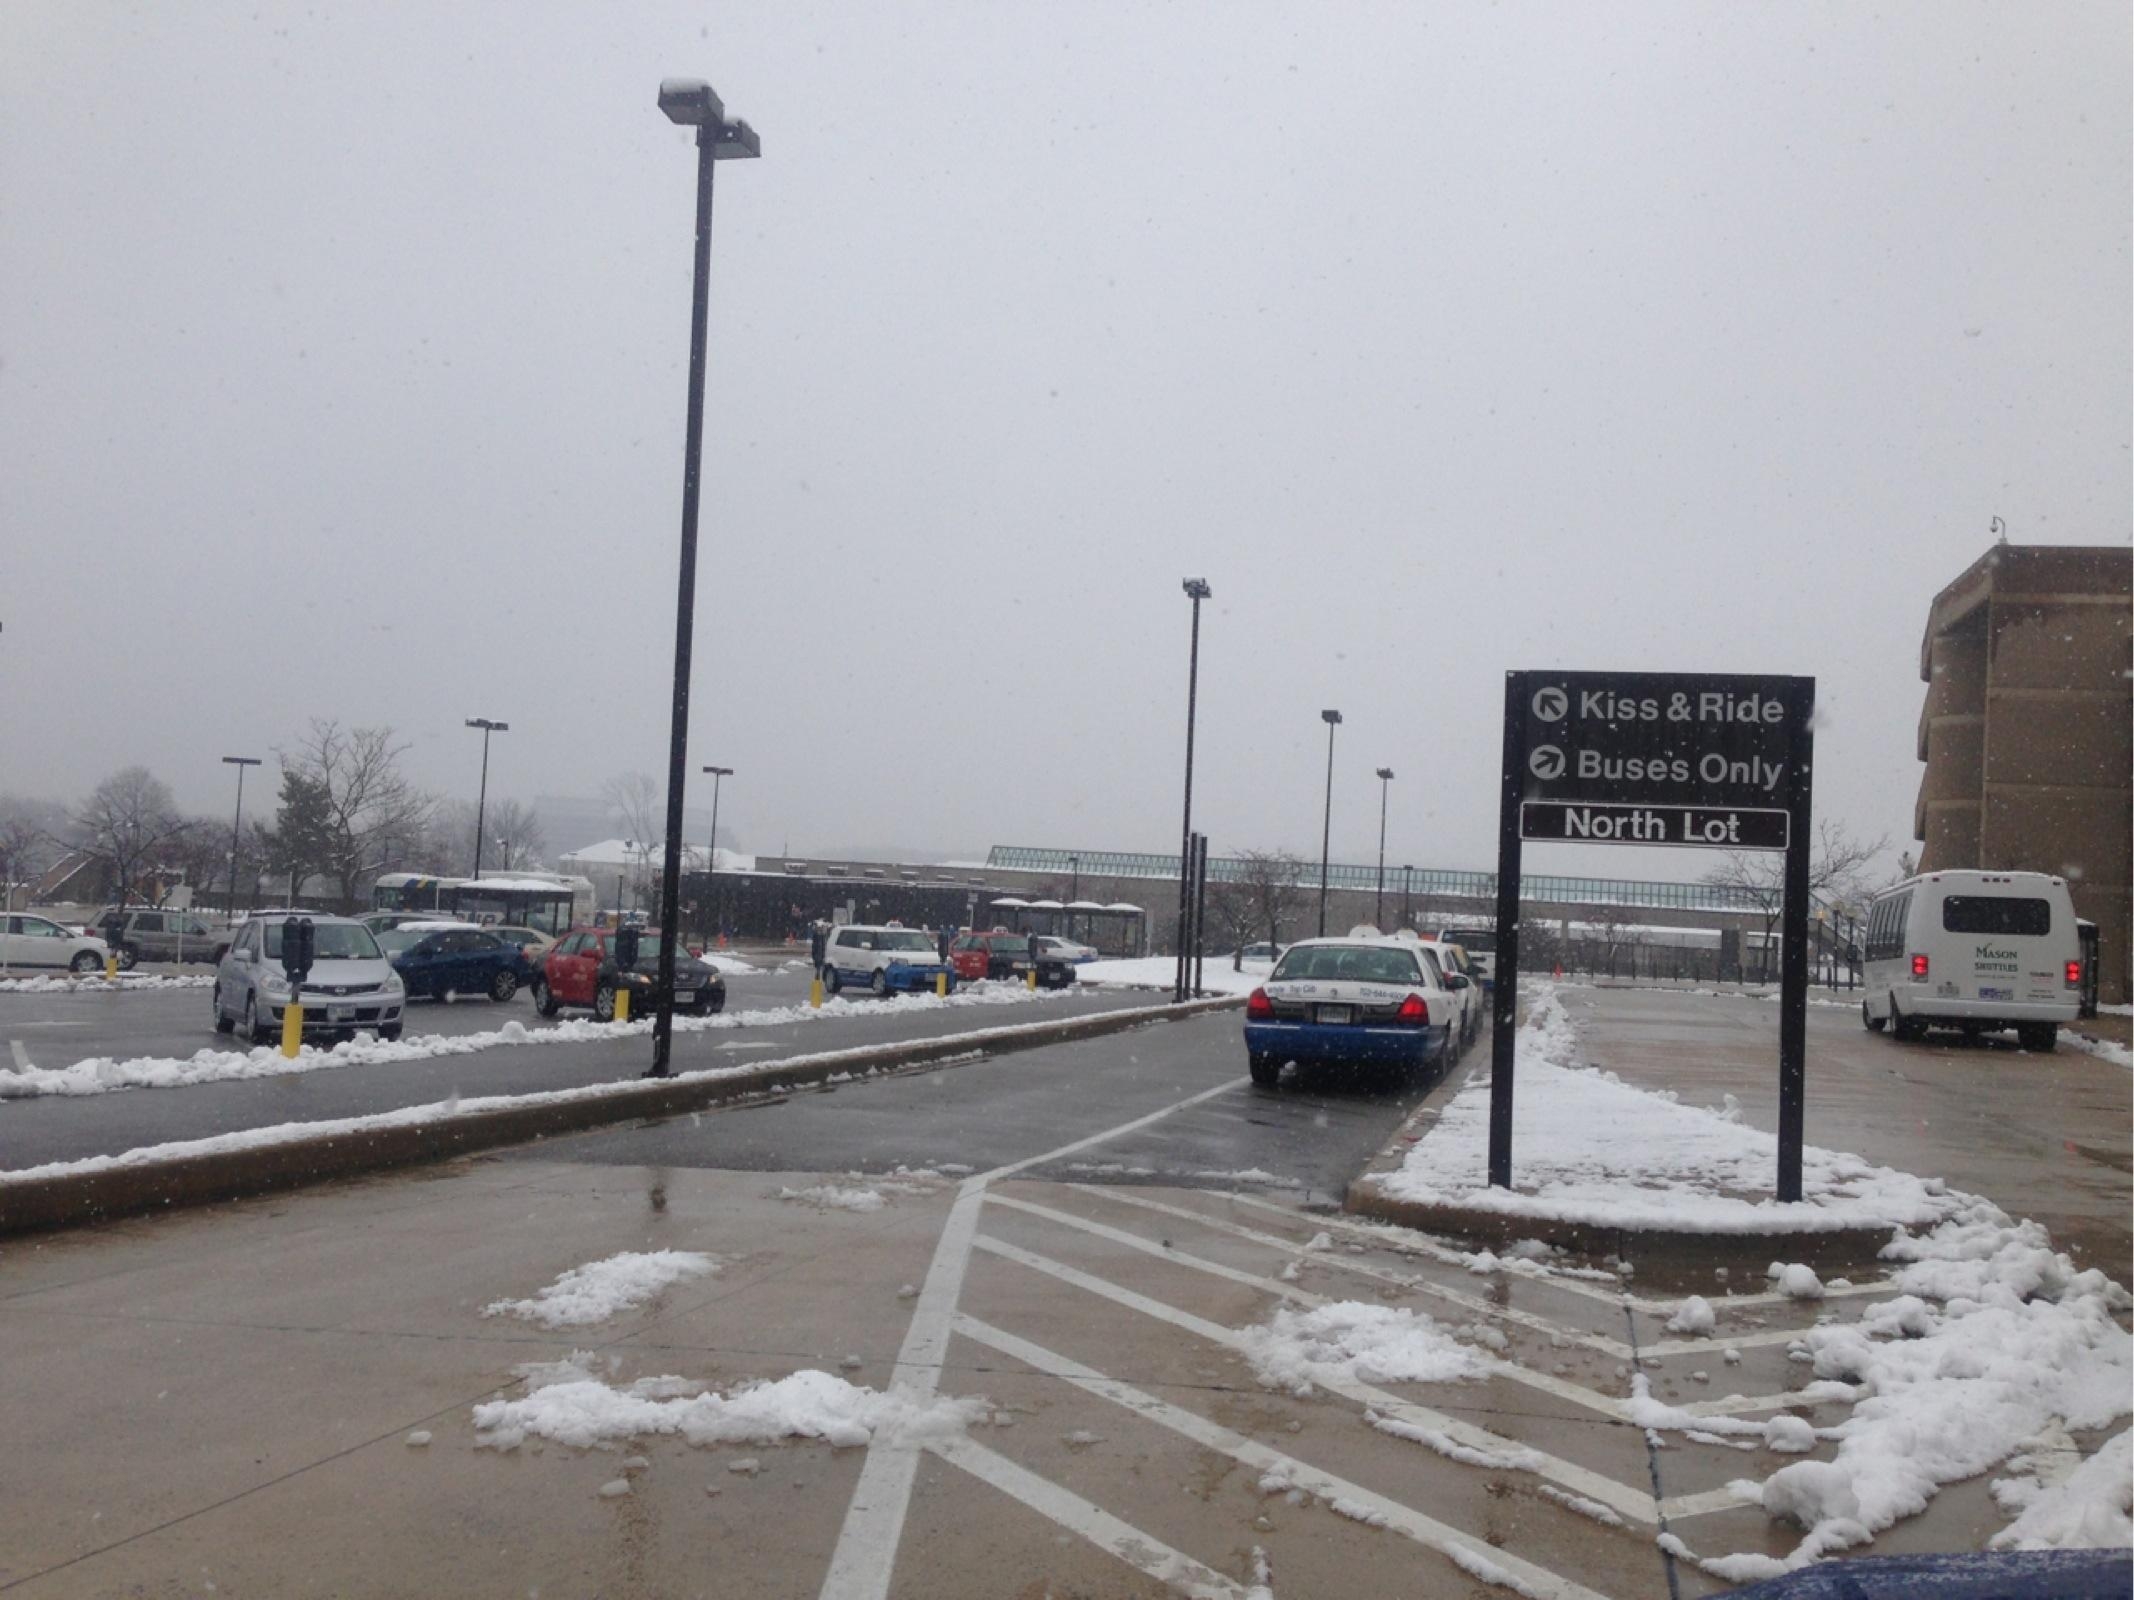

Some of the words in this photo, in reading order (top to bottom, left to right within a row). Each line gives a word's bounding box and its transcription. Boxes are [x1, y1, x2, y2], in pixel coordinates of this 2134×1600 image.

[1580, 691, 1659, 721] Kiss
[1666, 692, 1692, 721] &
[1700, 693, 1784, 722] Ride
[1577, 750, 1689, 781] Buses
[1700, 753, 1783, 790] Only
[1564, 807, 1666, 840] North
[1683, 812, 1740, 843] Lot
[1976, 945, 2017, 959] MASON
